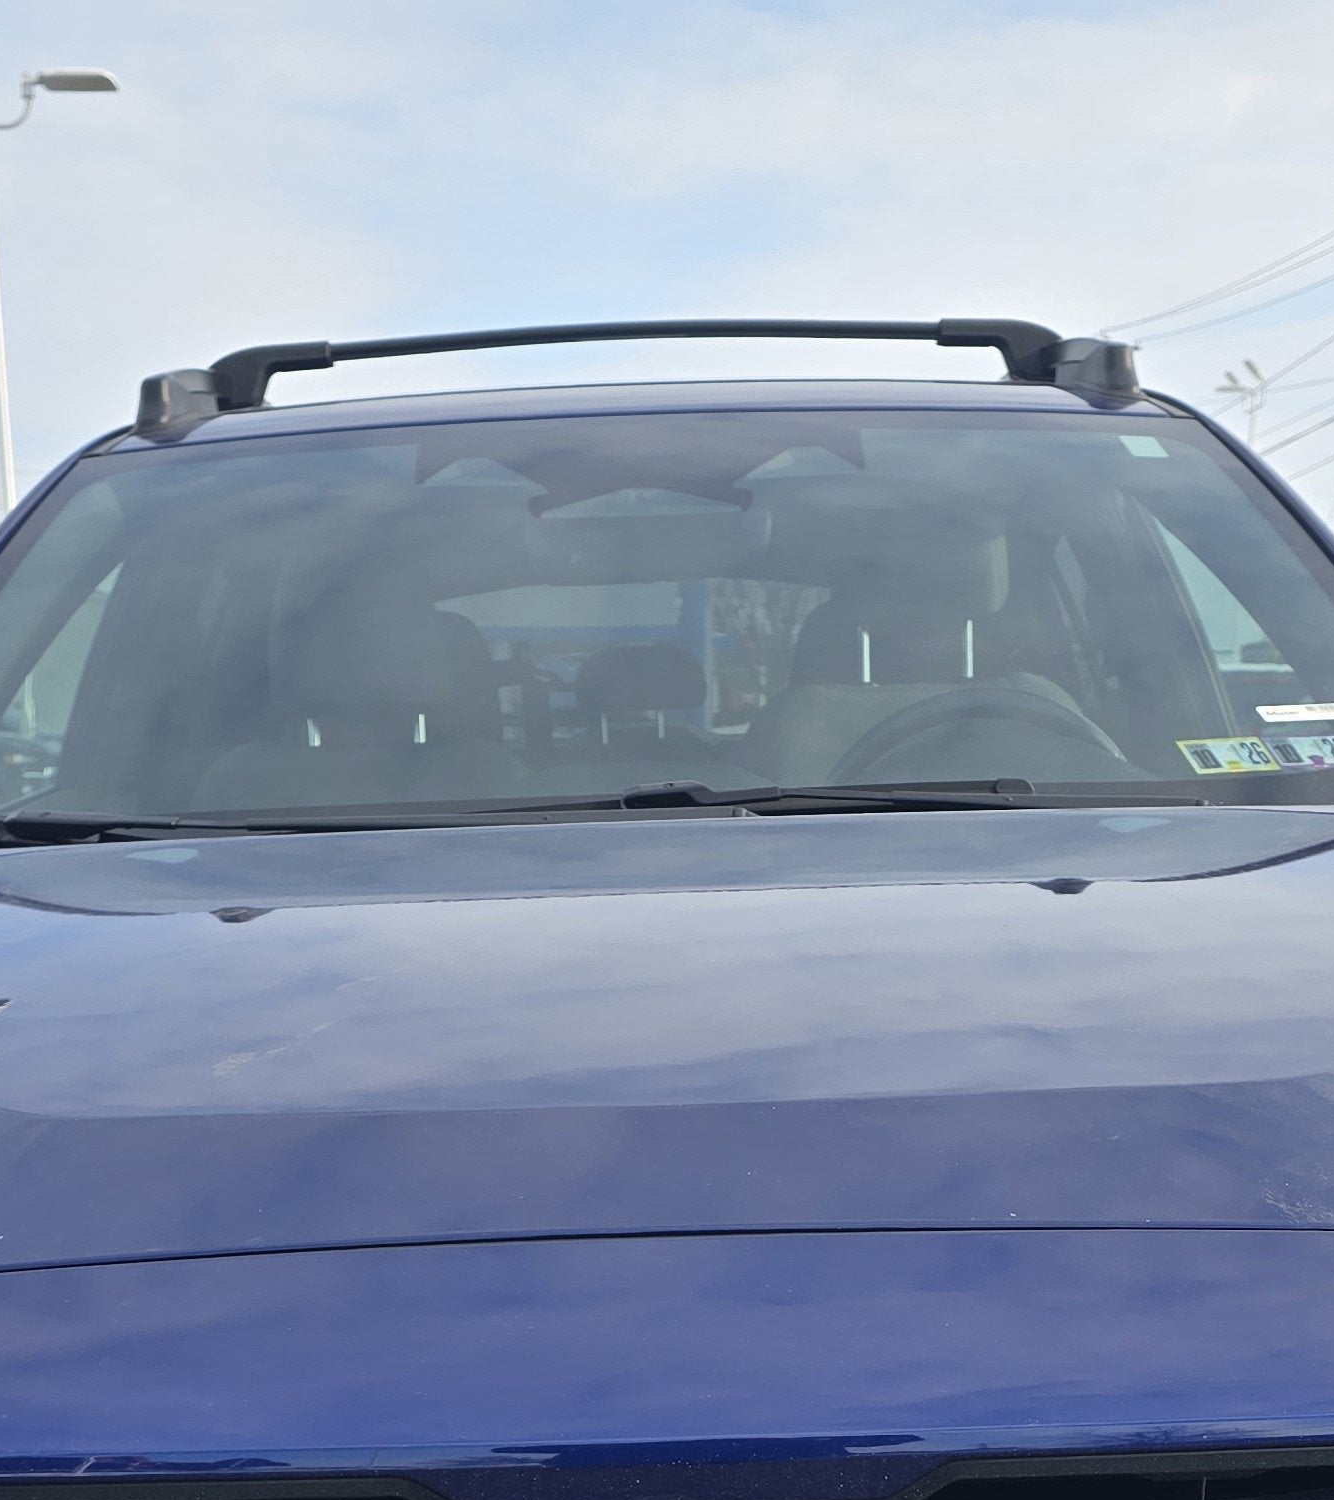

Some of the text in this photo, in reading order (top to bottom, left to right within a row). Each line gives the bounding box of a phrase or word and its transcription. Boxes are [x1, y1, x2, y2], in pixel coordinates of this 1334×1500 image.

[1191, 742, 1270, 769] 10 26
[1273, 744, 1304, 763] 10
